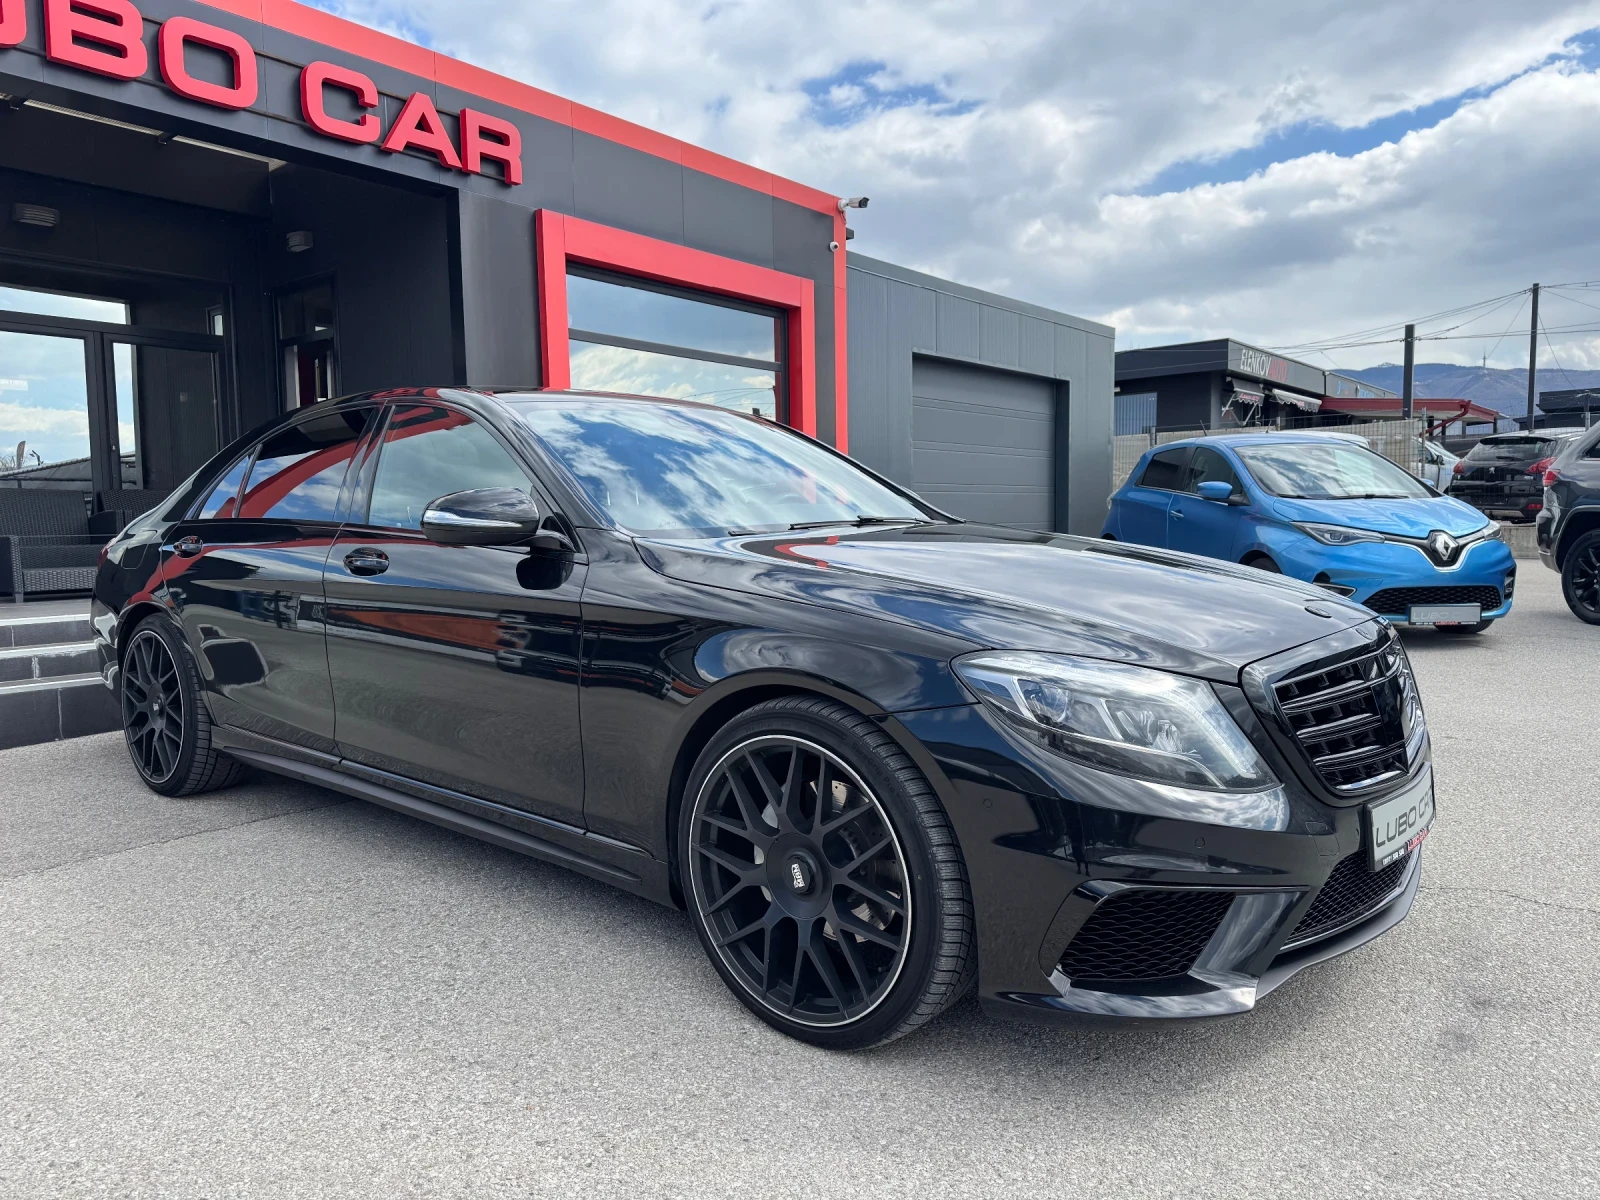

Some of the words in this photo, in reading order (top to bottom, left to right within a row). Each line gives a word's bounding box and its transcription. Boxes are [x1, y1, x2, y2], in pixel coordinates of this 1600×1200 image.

[0, 0, 258, 110] BO
[301, 61, 522, 185] CAR
[1376, 805, 1416, 848] LUBO
